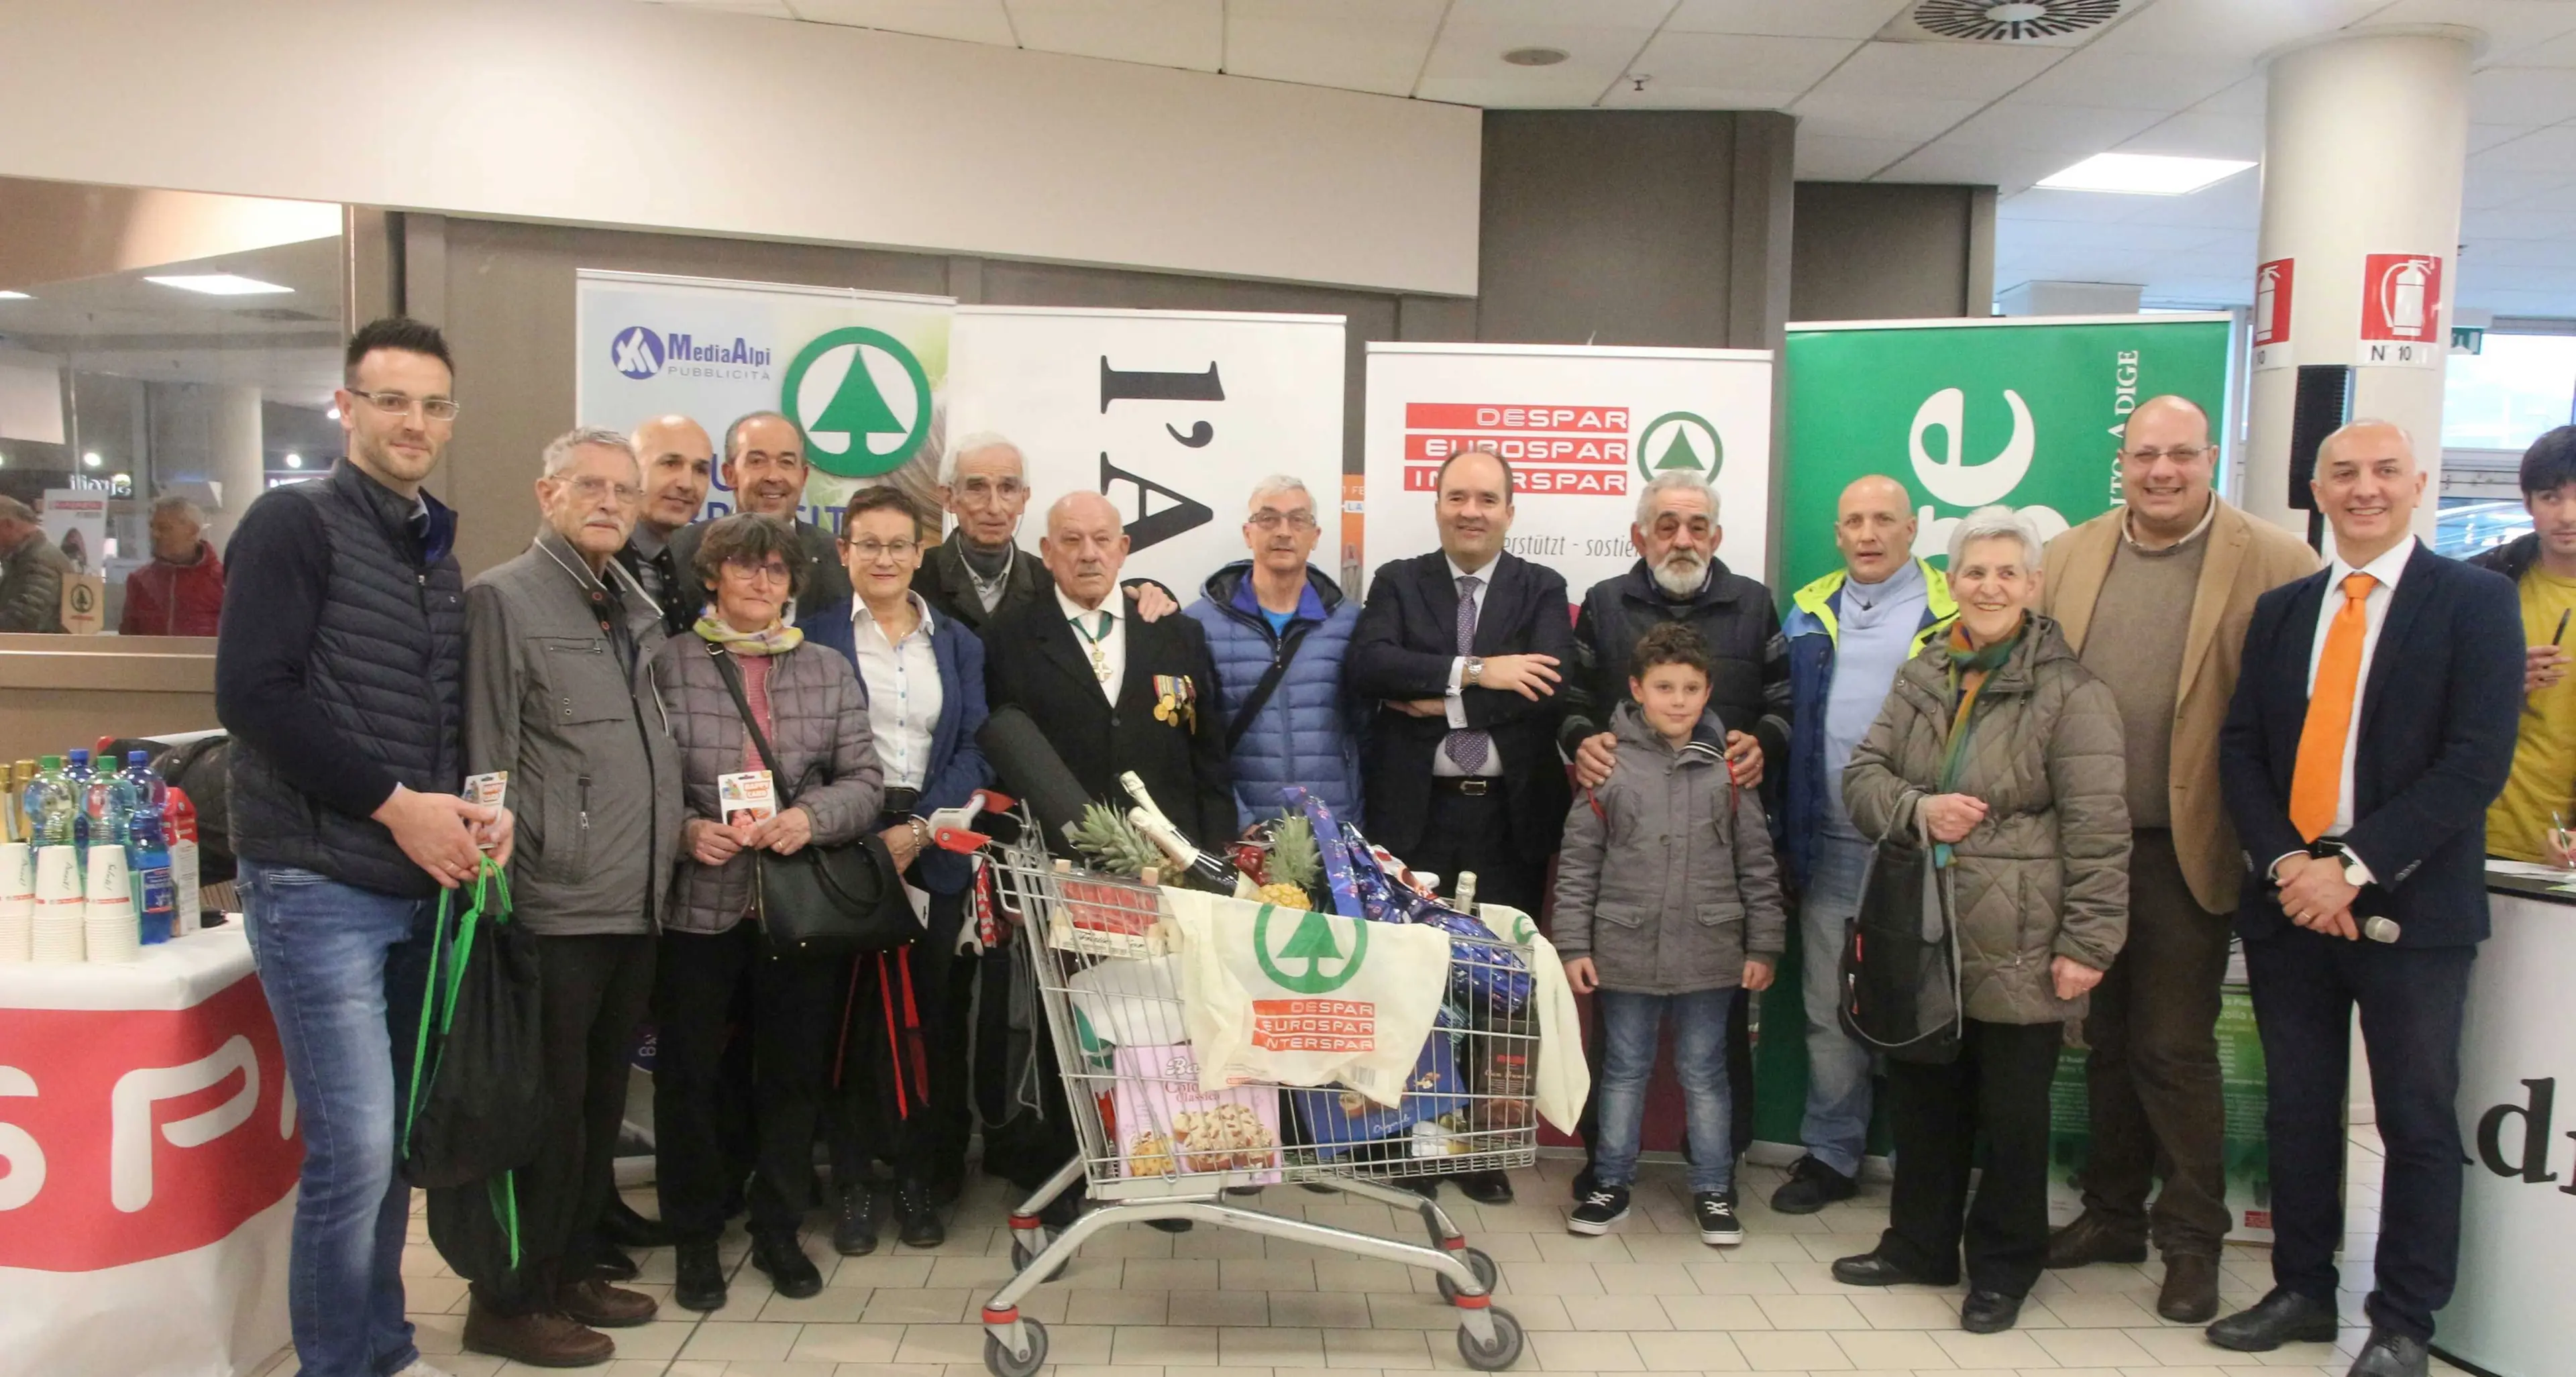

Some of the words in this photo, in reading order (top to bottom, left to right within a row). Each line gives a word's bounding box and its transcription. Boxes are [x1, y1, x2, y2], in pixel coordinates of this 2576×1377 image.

[669, 333, 771, 367] MediaAlpi
[2399, 345, 2412, 361] 10
[667, 366, 771, 380] PUBBLICITÀ
[1477, 408, 1627, 429] DESPAR
[1101, 355, 1225, 612] l'A
[1503, 535, 1565, 555] erstützt
[1291, 1001, 1374, 1015] DESPAR
[1262, 1020, 1373, 1034] EUROSPAR
[1265, 1038, 1373, 1050] NTERSPAR
[1165, 1056, 1201, 1075] Ba
